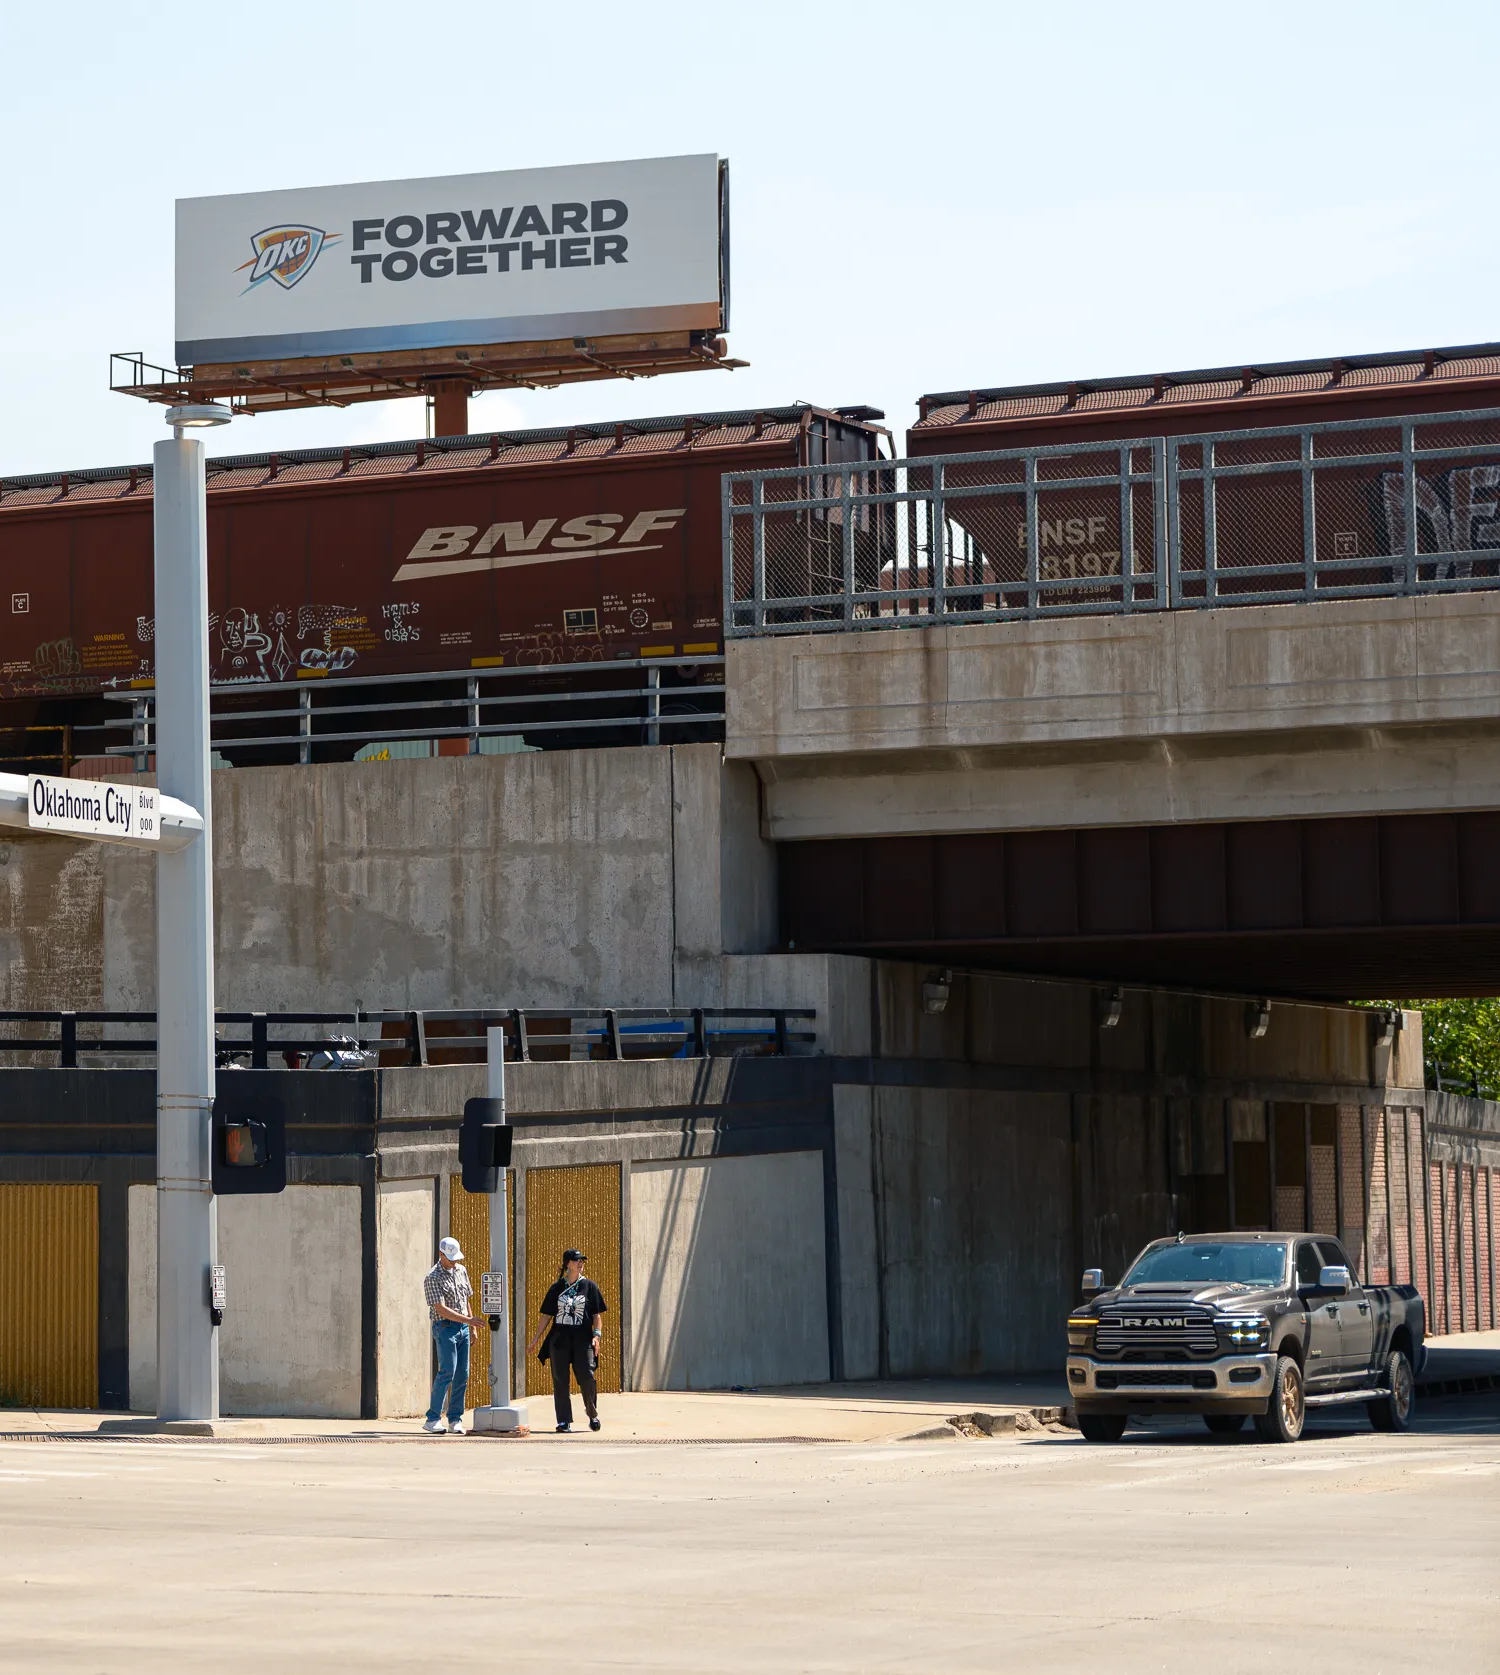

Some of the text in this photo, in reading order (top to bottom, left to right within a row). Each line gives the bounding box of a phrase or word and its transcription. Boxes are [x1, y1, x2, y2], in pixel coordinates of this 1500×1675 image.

[352, 199, 628, 251] FORWARD
[351, 234, 629, 283] TOGETHER
[406, 508, 687, 559] BNSF
[34, 779, 131, 832] Oklahoma City
[140, 796, 153, 809] Blvd
[140, 818, 153, 831] 000
[1124, 1318, 1183, 1327] RAM
